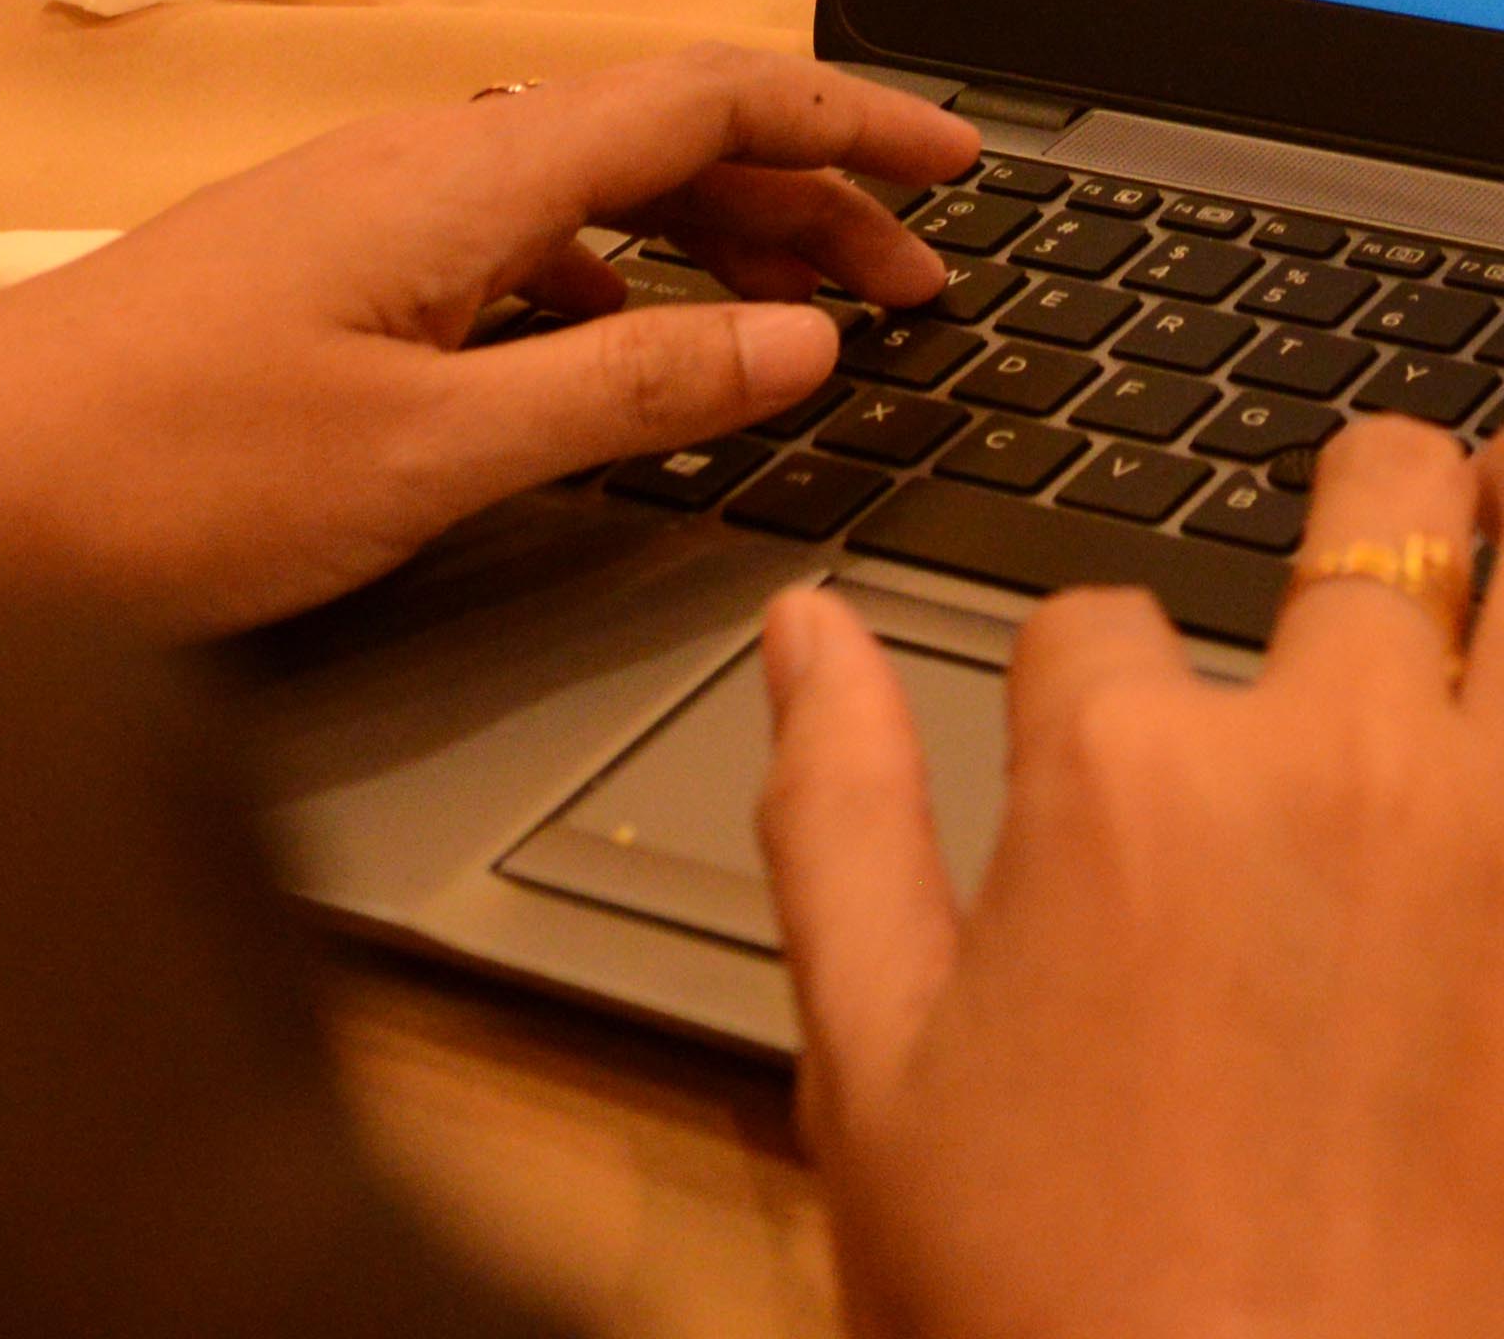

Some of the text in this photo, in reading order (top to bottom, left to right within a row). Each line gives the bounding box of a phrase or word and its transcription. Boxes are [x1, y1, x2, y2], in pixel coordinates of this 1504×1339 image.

[924, 219, 947, 233] 2
[1034, 239, 1058, 253] 3
[1149, 265, 1171, 279] 4
[1040, 290, 1069, 308] E
[1263, 287, 1286, 303] 5
[1156, 315, 1184, 333] R
[1381, 312, 1405, 327] 6
[884, 330, 910, 347] S
[1280, 338, 1303, 355] T
[998, 356, 1027, 373] D
[1405, 365, 1430, 383] Y
[1116, 380, 1145, 397] F
[863, 402, 895, 421] X
[1241, 407, 1270, 426] G
[985, 431, 1013, 448] C
[1112, 458, 1140, 477] V
[1227, 490, 1256, 509] B
